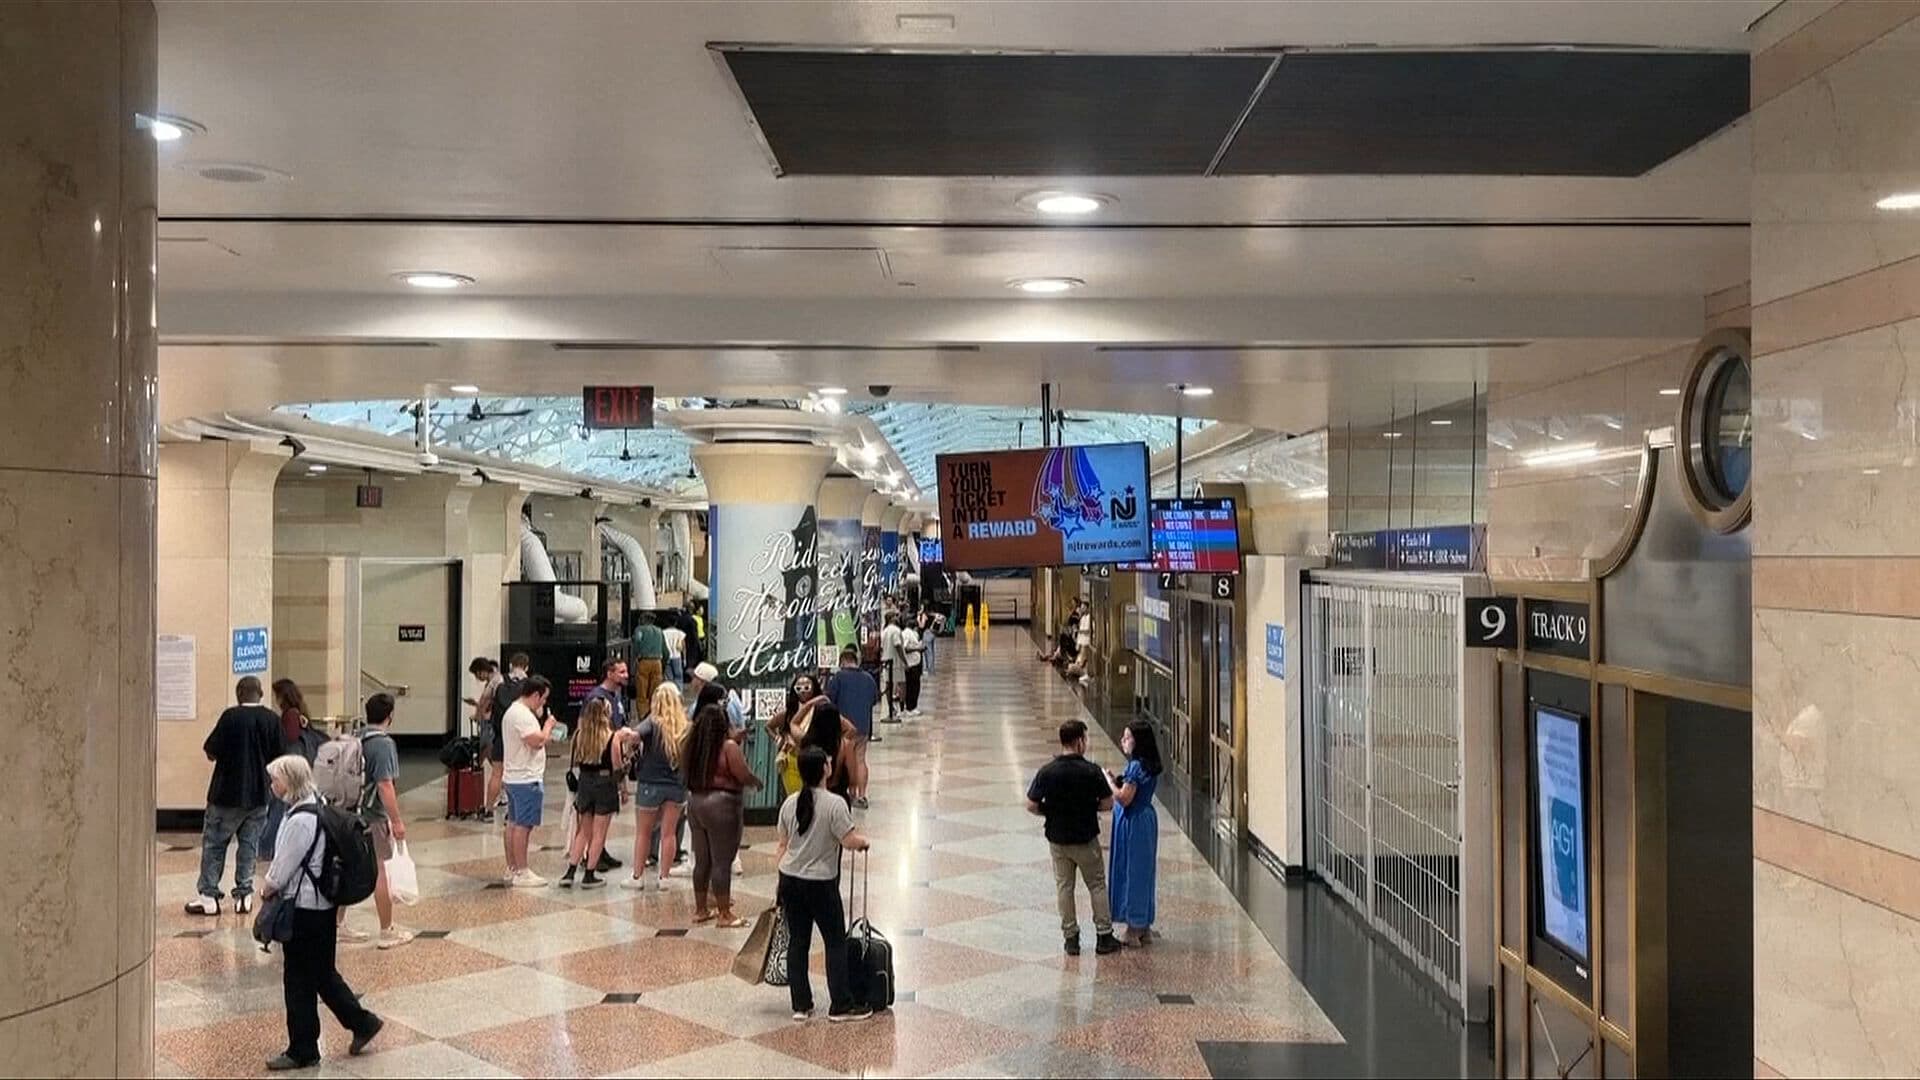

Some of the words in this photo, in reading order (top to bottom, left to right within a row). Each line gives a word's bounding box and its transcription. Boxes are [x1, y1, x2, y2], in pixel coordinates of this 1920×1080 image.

[595, 386, 640, 422] EXIT
[948, 462, 990, 478] TURN
[950, 477, 992, 493] YOUR
[951, 491, 1006, 508] TICKET
[952, 507, 987, 523] INTO
[953, 525, 963, 539] A
[968, 520, 1037, 538] REWARD
[1101, 566, 1109, 577] 6
[1162, 573, 1171, 588] 7
[1217, 578, 1230, 597] 8
[1481, 605, 1506, 640] 9
[1532, 612, 1575, 642] TRACK
[1578, 616, 1587, 645] 9
[1552, 818, 1576, 860] AG1
